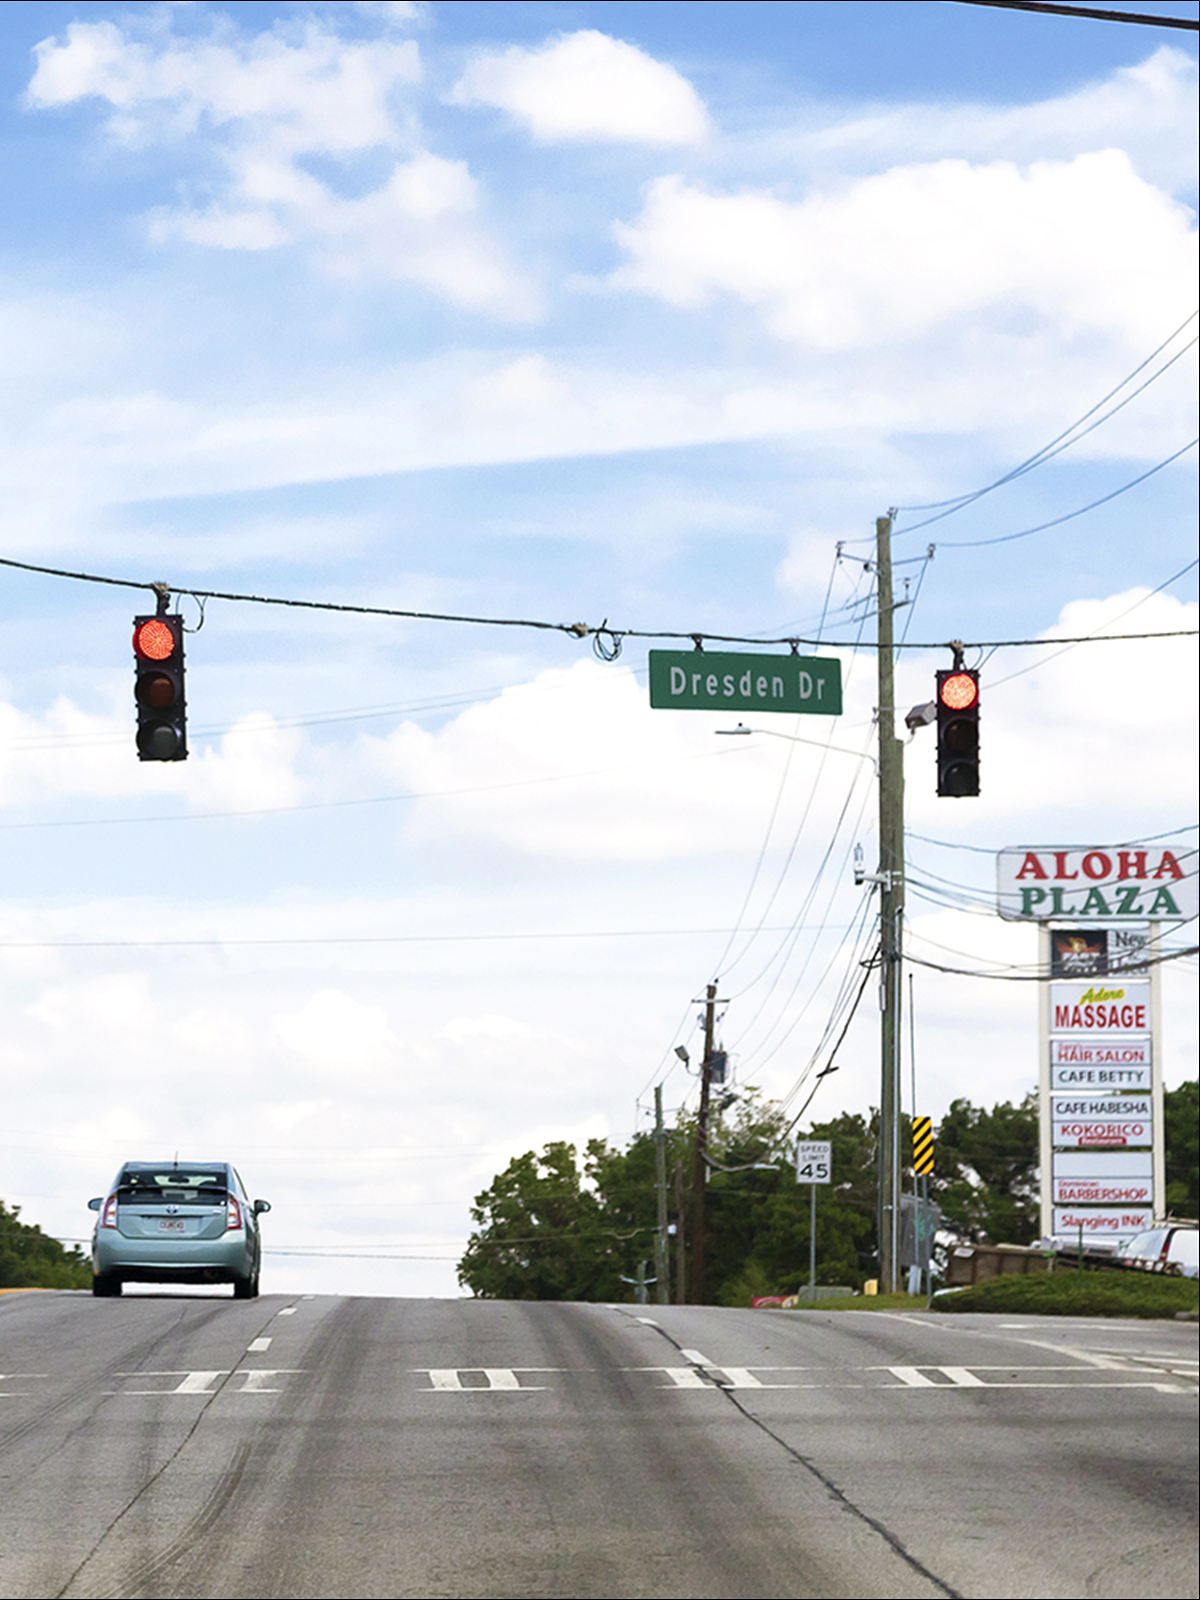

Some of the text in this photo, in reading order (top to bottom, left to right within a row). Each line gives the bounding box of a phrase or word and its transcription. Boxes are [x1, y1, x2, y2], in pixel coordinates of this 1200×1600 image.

[670, 666, 825, 699] Dresden Dr
[1015, 851, 1185, 880] ALOHA
[1019, 886, 1182, 916] PLAZA
[1079, 986, 1125, 1006] Adore
[1055, 1005, 1145, 1028] MASSAGE
[1058, 1050, 1145, 1063] HAIR SALON
[1059, 1070, 1144, 1082] CAFE BETTY
[1056, 1102, 1148, 1114] CAFE HABESHA
[1061, 1124, 1144, 1137] KOKORICO
[801, 1145, 829, 1153] SPEED
[803, 1154, 825, 1162] LIMIT
[800, 1163, 828, 1179] 45
[1058, 1188, 1148, 1200] BARBERSHOP
[1061, 1215, 1146, 1230] Slanging INK
